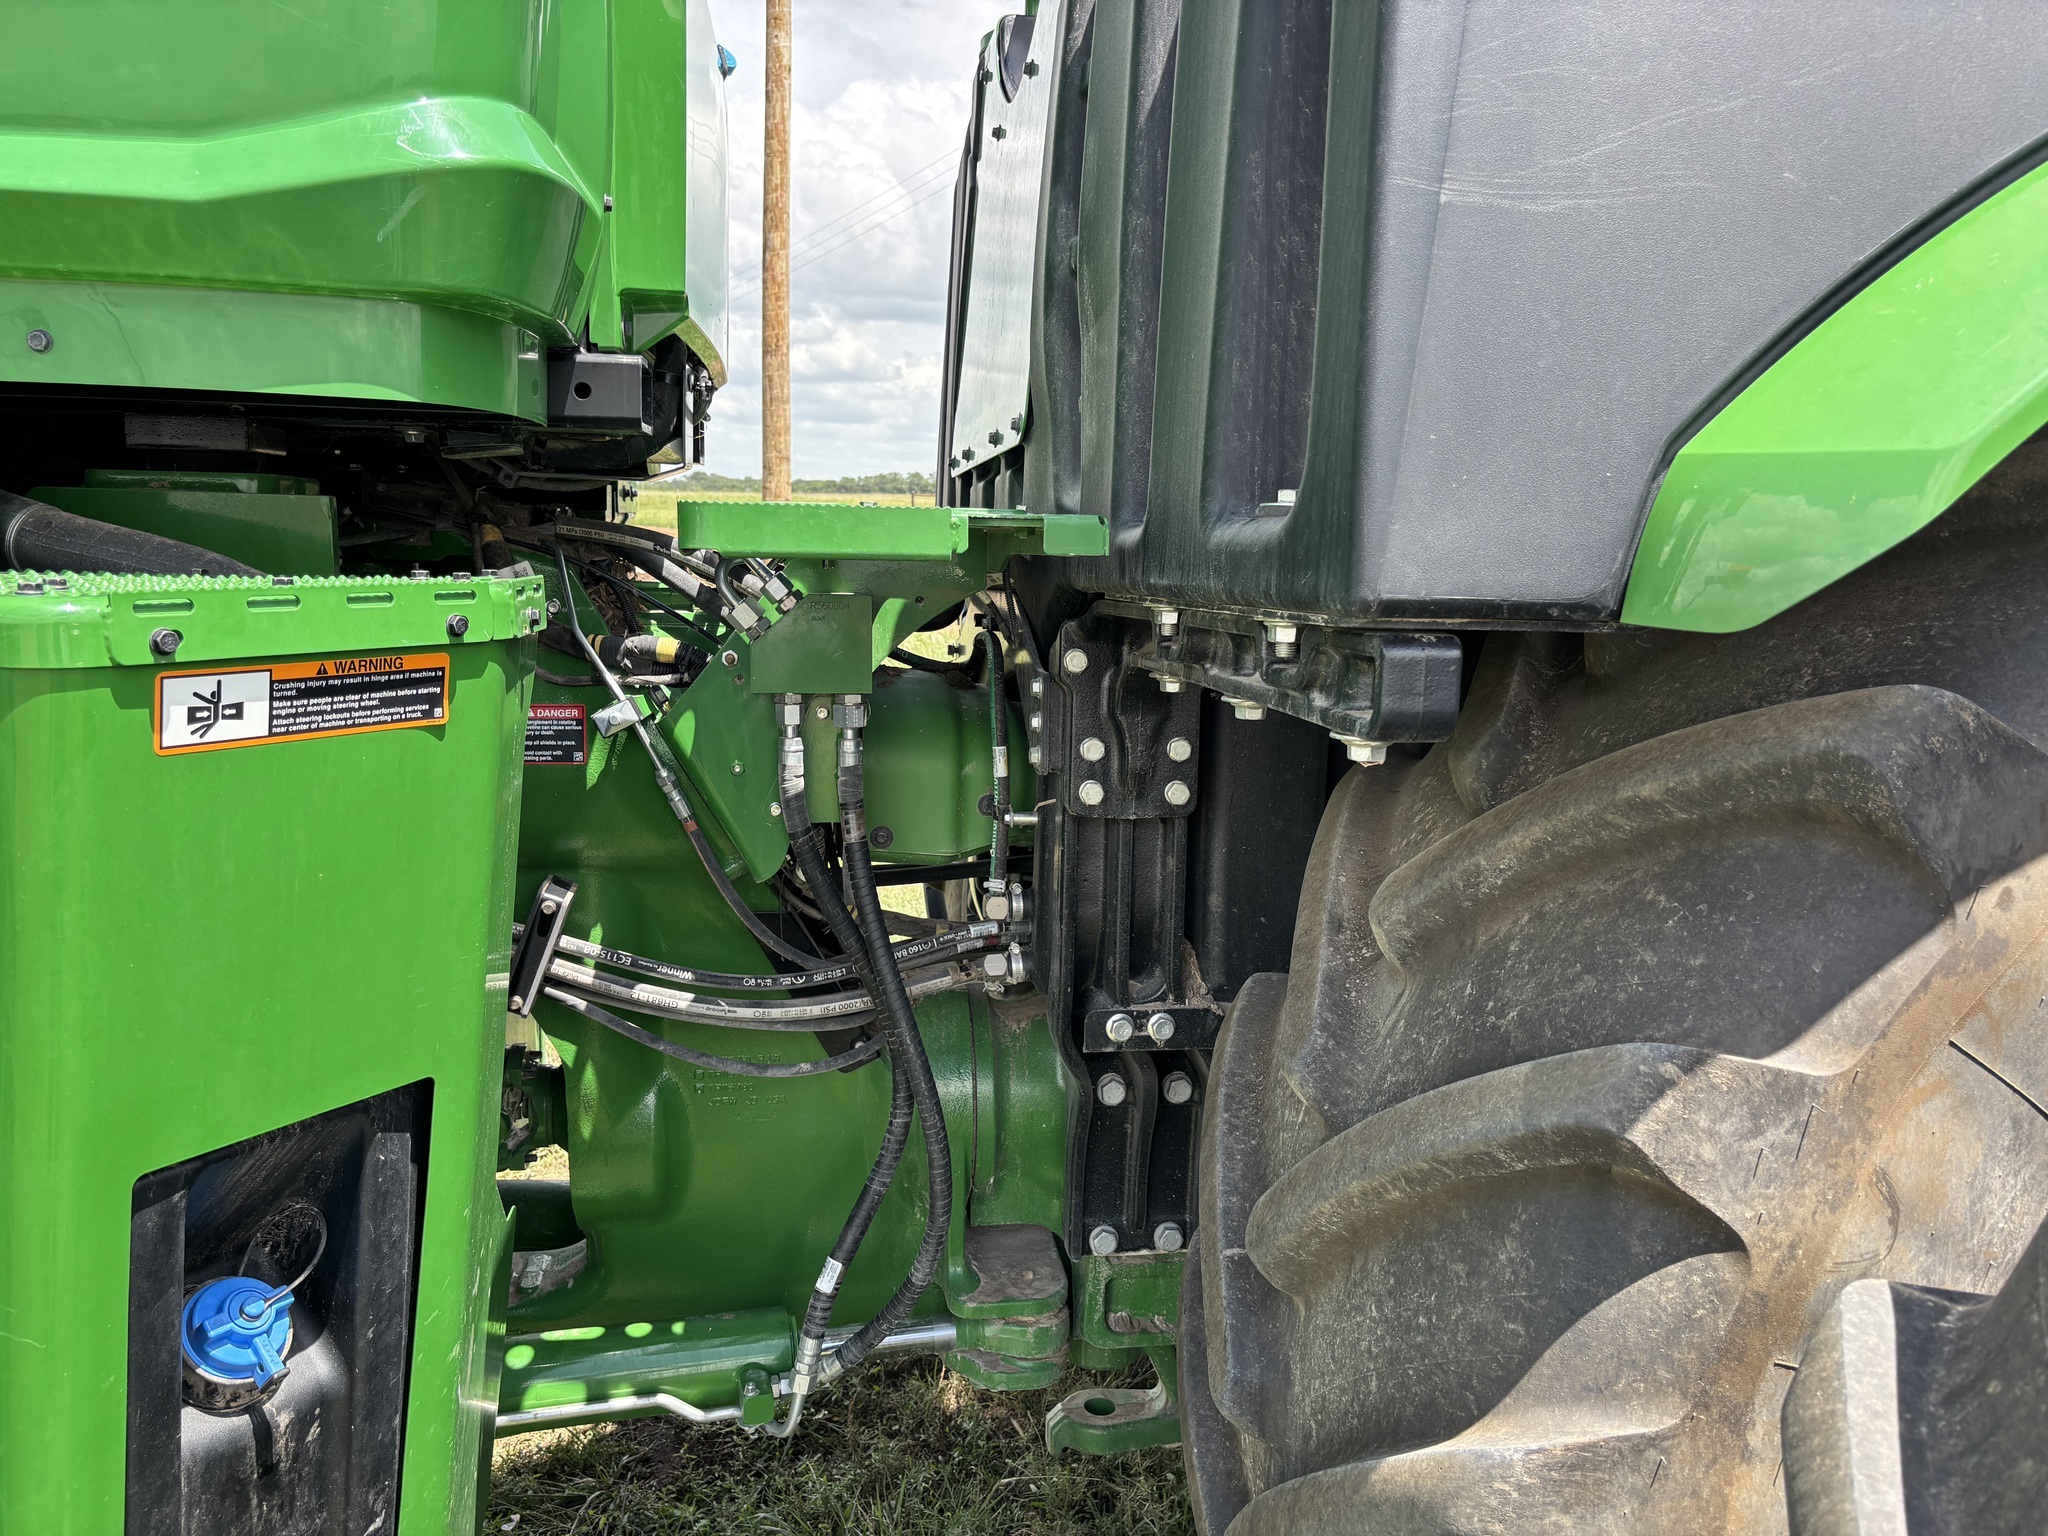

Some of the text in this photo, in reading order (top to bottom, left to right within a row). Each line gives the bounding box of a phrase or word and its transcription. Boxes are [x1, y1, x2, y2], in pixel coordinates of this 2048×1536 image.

[578, 529, 594, 537] (3000
[656, 545, 672, 555] Parker
[334, 656, 404, 674] WARNING
[273, 681, 306, 690] Crushing
[306, 680, 326, 688] injury
[371, 674, 388, 682] hinge
[410, 670, 436, 678] machine
[272, 700, 291, 708] Make
[310, 696, 332, 706] people
[370, 690, 396, 698] machine
[273, 689, 298, 698] turned.
[272, 707, 296, 716] engine
[306, 702, 332, 712] moving
[332, 701, 359, 710] steering
[360, 698, 380, 707] wheel.
[537, 709, 578, 717] DANGER
[272, 717, 294, 726] Attach
[296, 714, 322, 724] steering
[324, 712, 350, 720] lockouts
[352, 709, 371, 718] before
[372, 706, 404, 716] performing
[272, 726, 288, 734] near
[288, 723, 310, 732] center
[318, 720, 346, 728] machine
[354, 715, 392, 724] transporting
[584, 945, 633, 966] EC115-08
[908, 944, 922, 955] 160
[656, 964, 692, 980] Winner
[630, 990, 678, 1008] GH681-12
[838, 998, 862, 1012] (2000
[820, 1006, 838, 1014] PSI)
